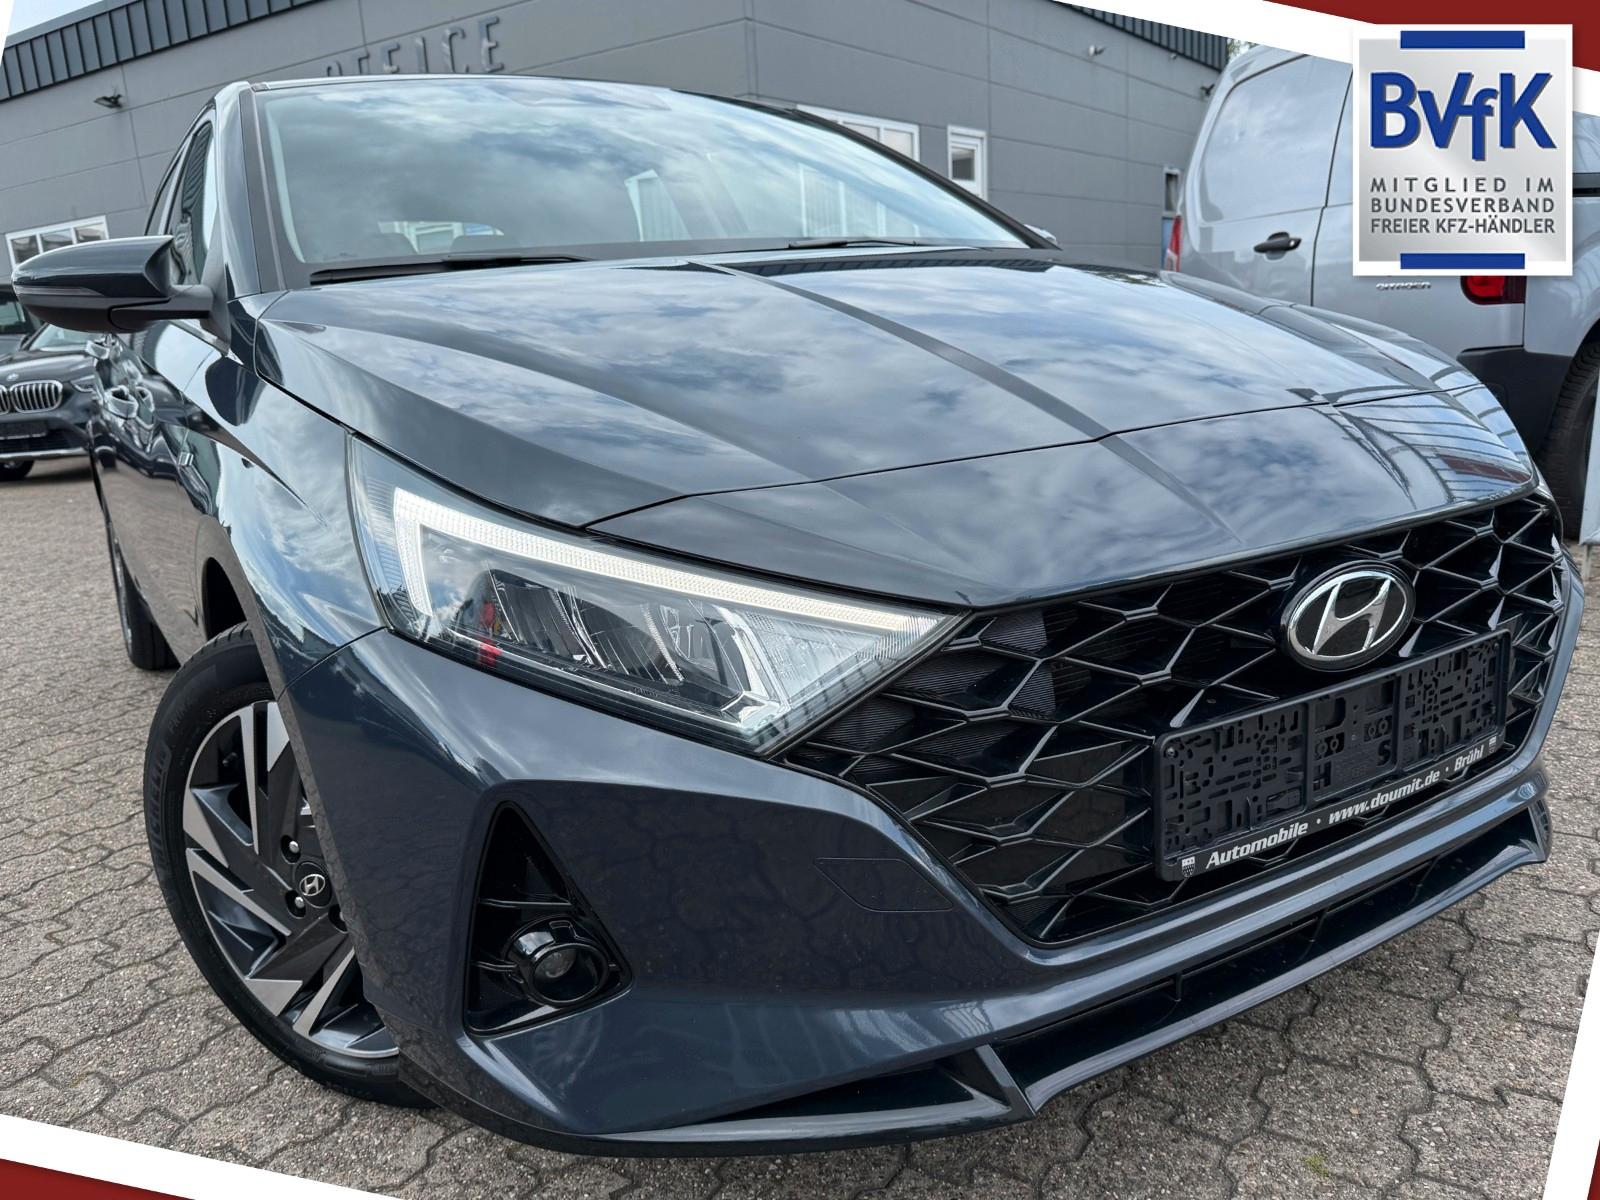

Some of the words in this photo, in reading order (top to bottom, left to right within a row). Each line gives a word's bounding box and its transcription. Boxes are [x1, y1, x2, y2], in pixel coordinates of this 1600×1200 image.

[1205, 822, 1308, 869] Automobile
[1328, 771, 1440, 824] www.doumit.de
[1454, 745, 1484, 771] Brühl
